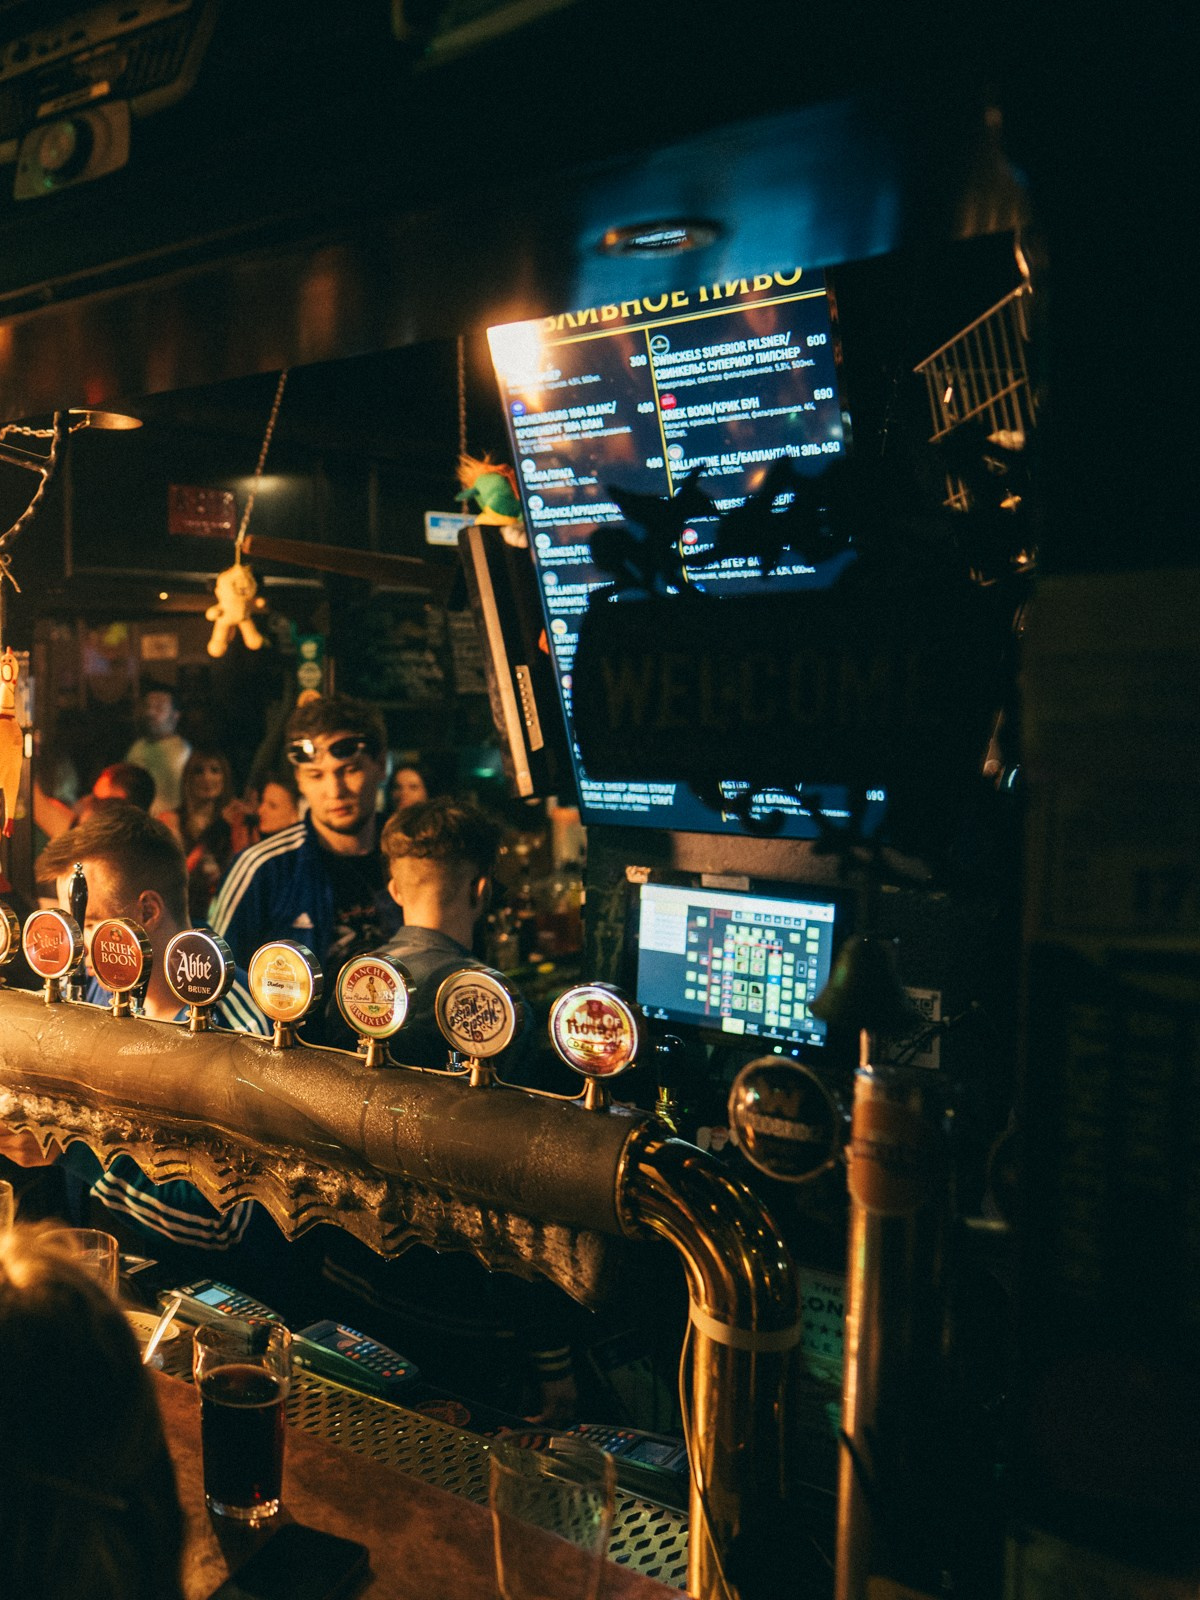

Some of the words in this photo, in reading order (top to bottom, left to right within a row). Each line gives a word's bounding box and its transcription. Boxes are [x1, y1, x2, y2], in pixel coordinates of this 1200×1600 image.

[806, 333, 827, 347] 600
[702, 341, 747, 358] SUPERIOR
[707, 355, 754, 371] СУПЕРИОР
[755, 346, 800, 364] ПИЛСНЕР
[813, 387, 833, 401] 690
[801, 442, 820, 456] ЭЛЬ
[821, 441, 840, 454] 450
[100, 940, 137, 956] KRIEK
[101, 952, 137, 967] BOON
[176, 949, 212, 984] Abbé
[187, 984, 212, 995] BRUNE
